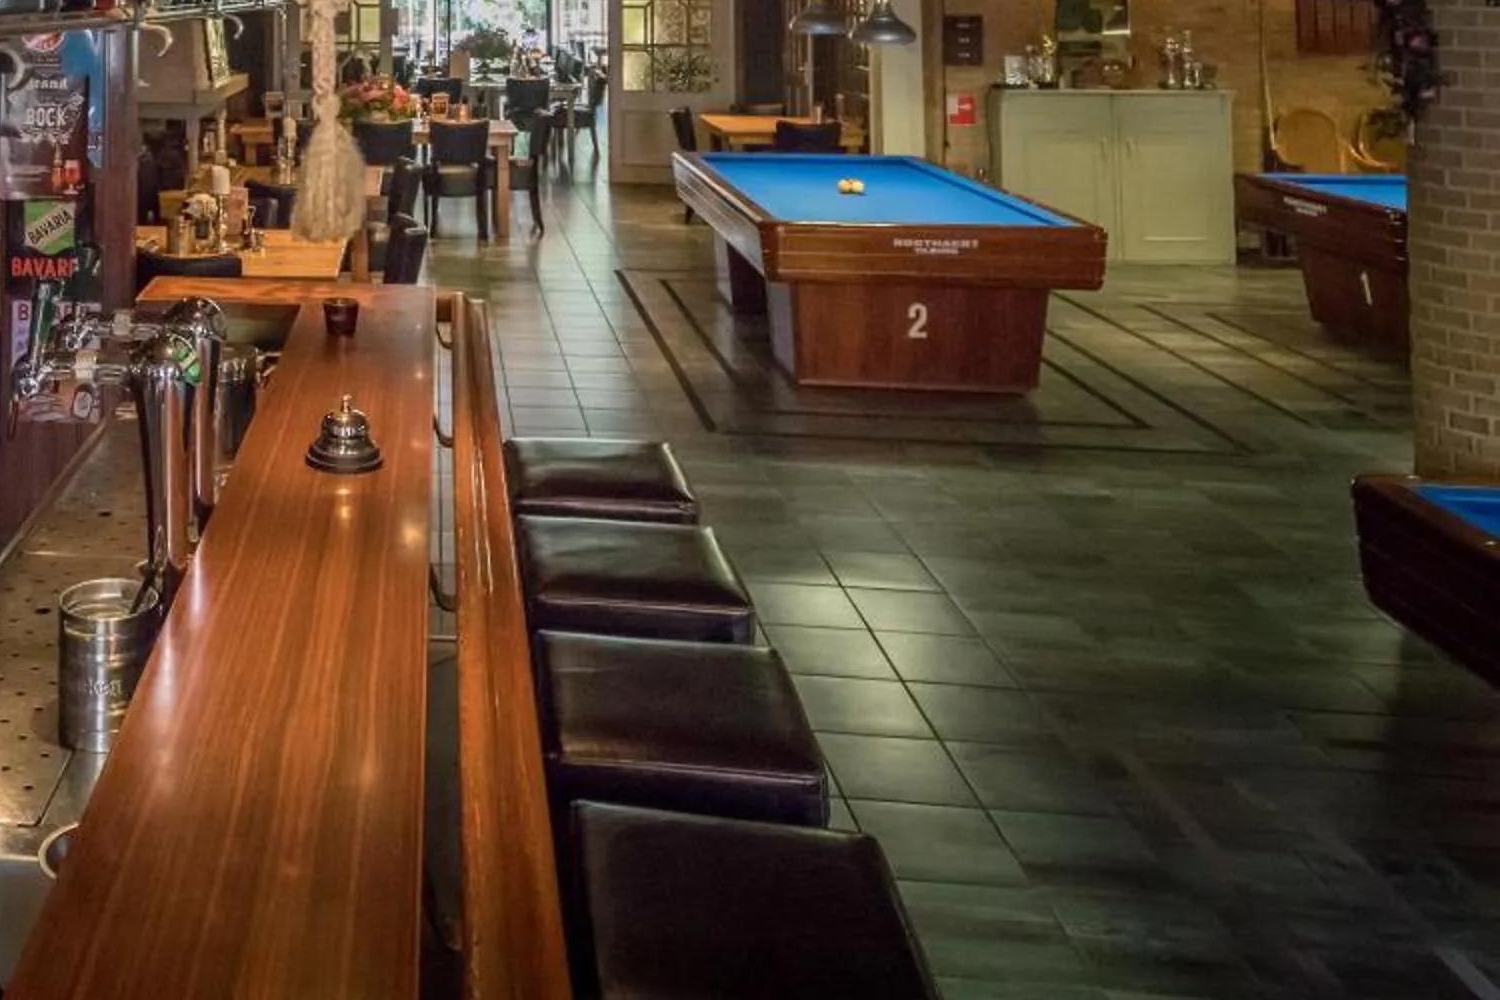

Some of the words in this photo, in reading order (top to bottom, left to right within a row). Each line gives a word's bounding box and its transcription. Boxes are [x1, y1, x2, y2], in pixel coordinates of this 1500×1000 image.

[26, 107, 69, 128] BOCK
[27, 207, 74, 246] BAVARIA
[10, 255, 75, 279] BAVARI
[908, 302, 928, 339] 2
